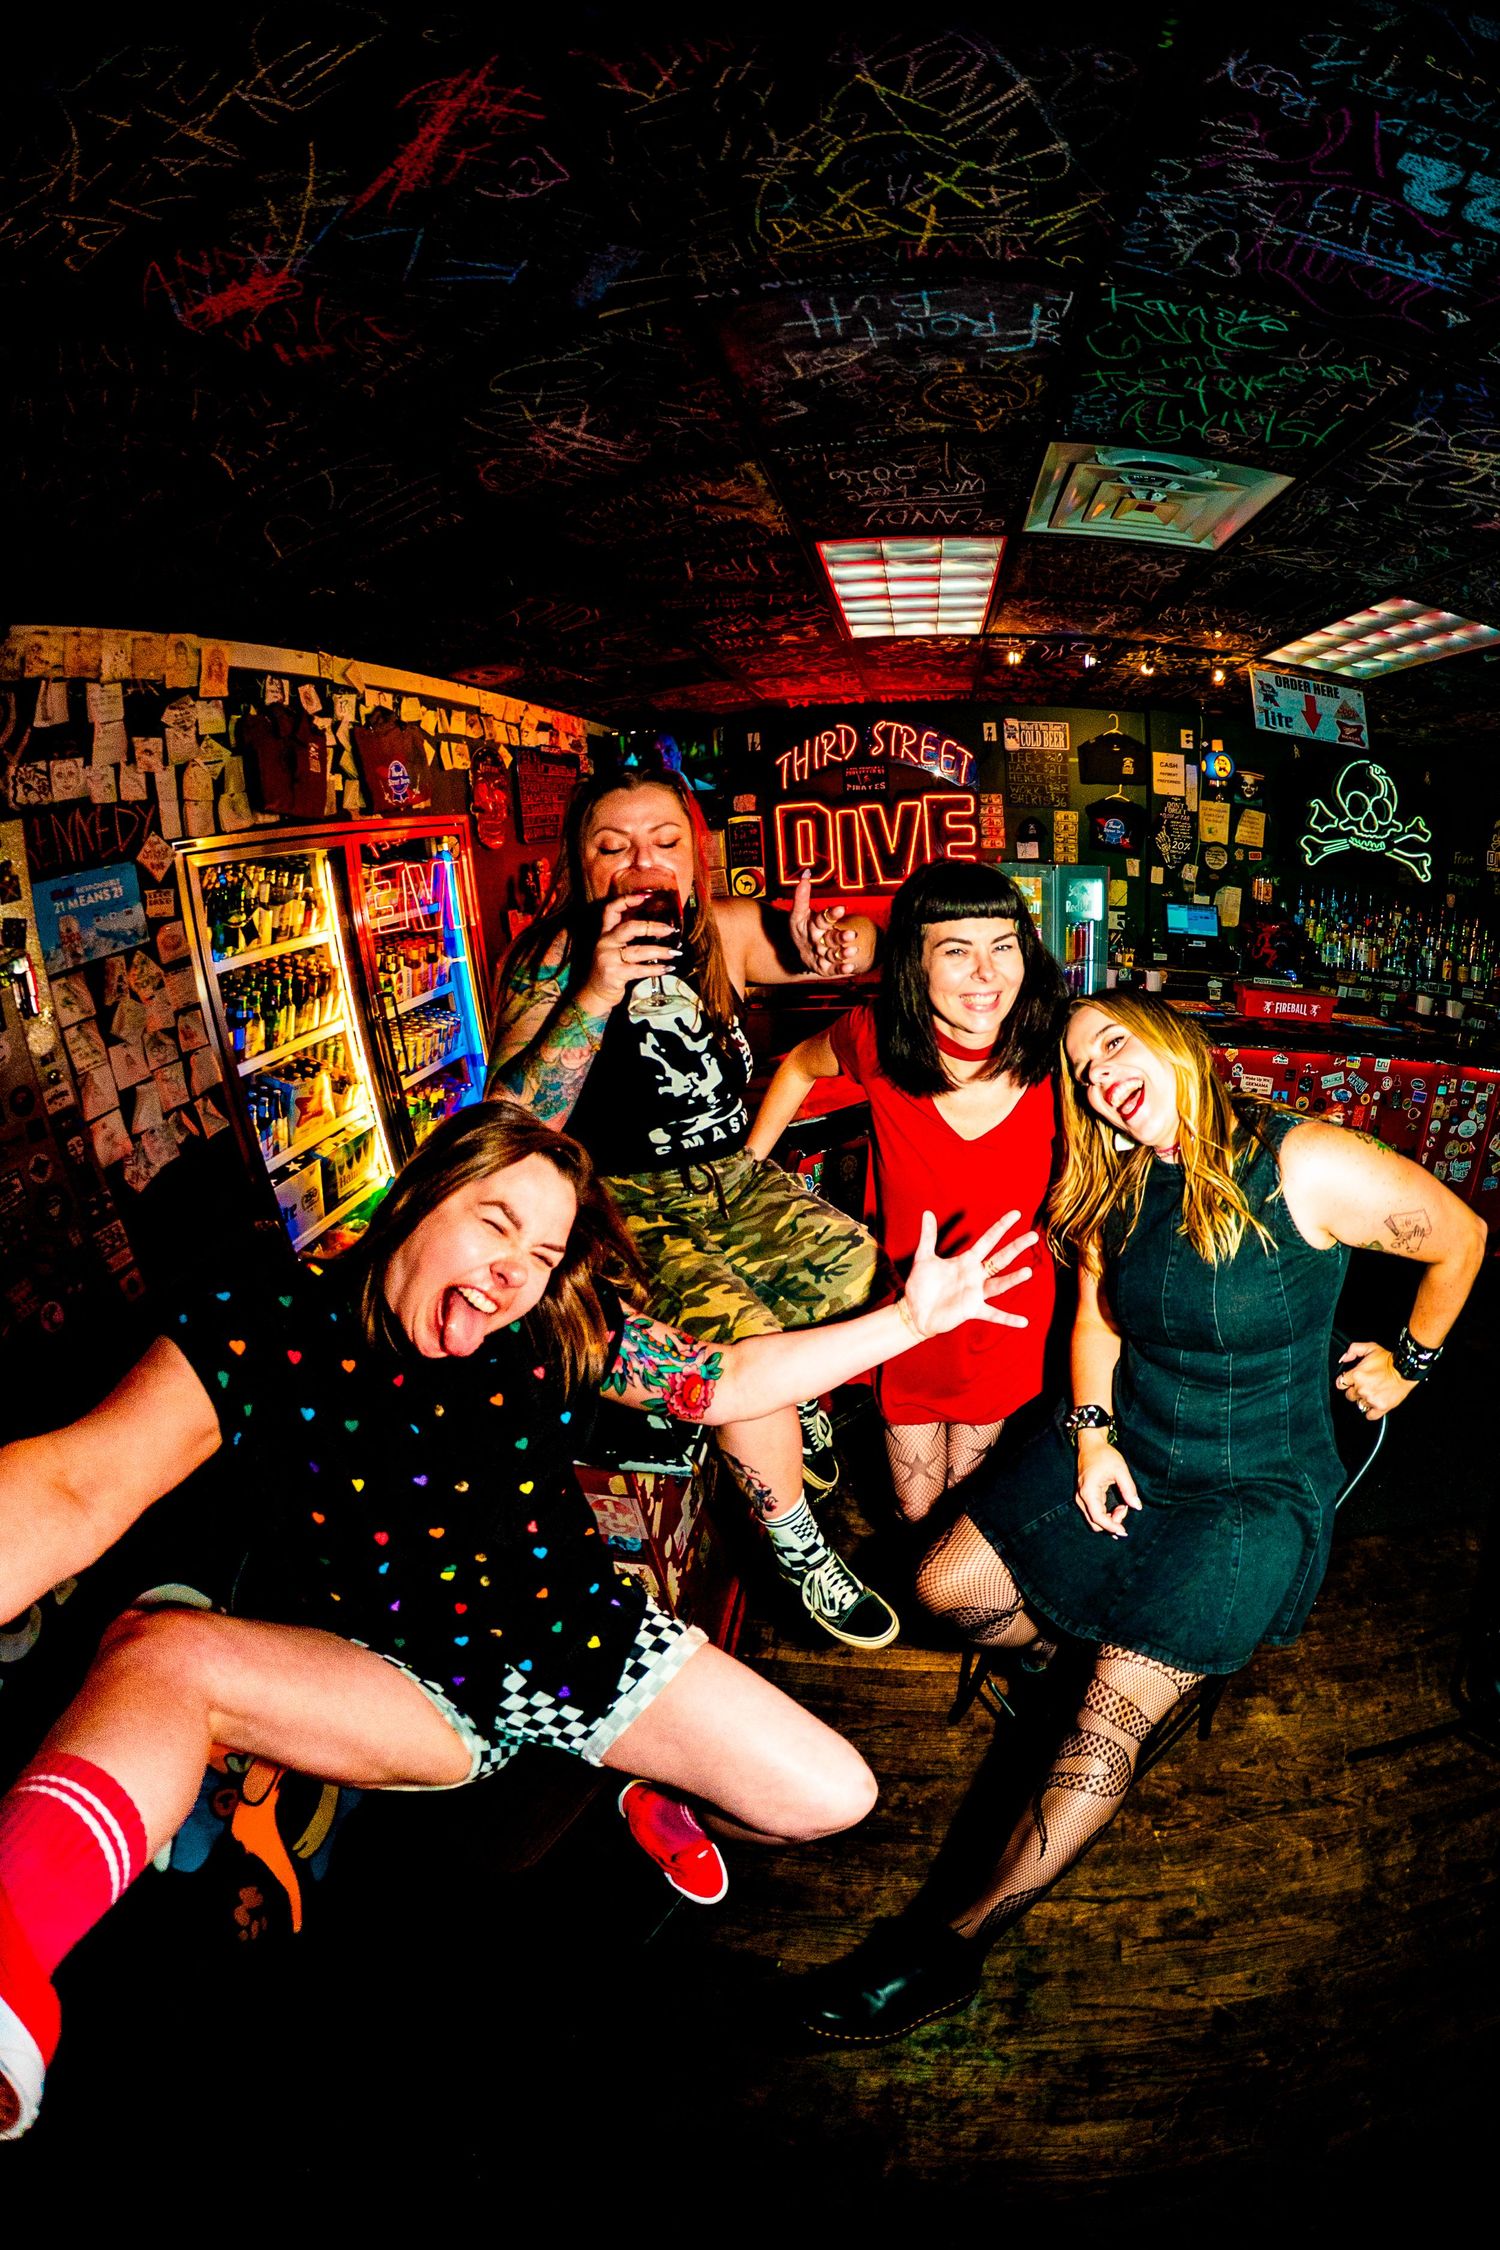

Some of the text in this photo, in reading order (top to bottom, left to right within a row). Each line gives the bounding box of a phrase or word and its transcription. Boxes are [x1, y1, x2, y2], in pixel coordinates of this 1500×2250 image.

[864, 505, 985, 530] CANDY
[1275, 675, 1340, 700] ORDER HERE
[1264, 709, 1293, 729] Lite
[1020, 730, 1065, 748] COLD BEER
[775, 719, 974, 790] THIRD STREET
[846, 781, 886, 791] PIRATES
[27, 801, 156, 872] ENNEDY
[775, 794, 977, 889] DIVE
[1171, 841, 1191, 851] 20%
[67, 889, 112, 910] MEANS
[1275, 1001, 1308, 1016] FIREBALL
